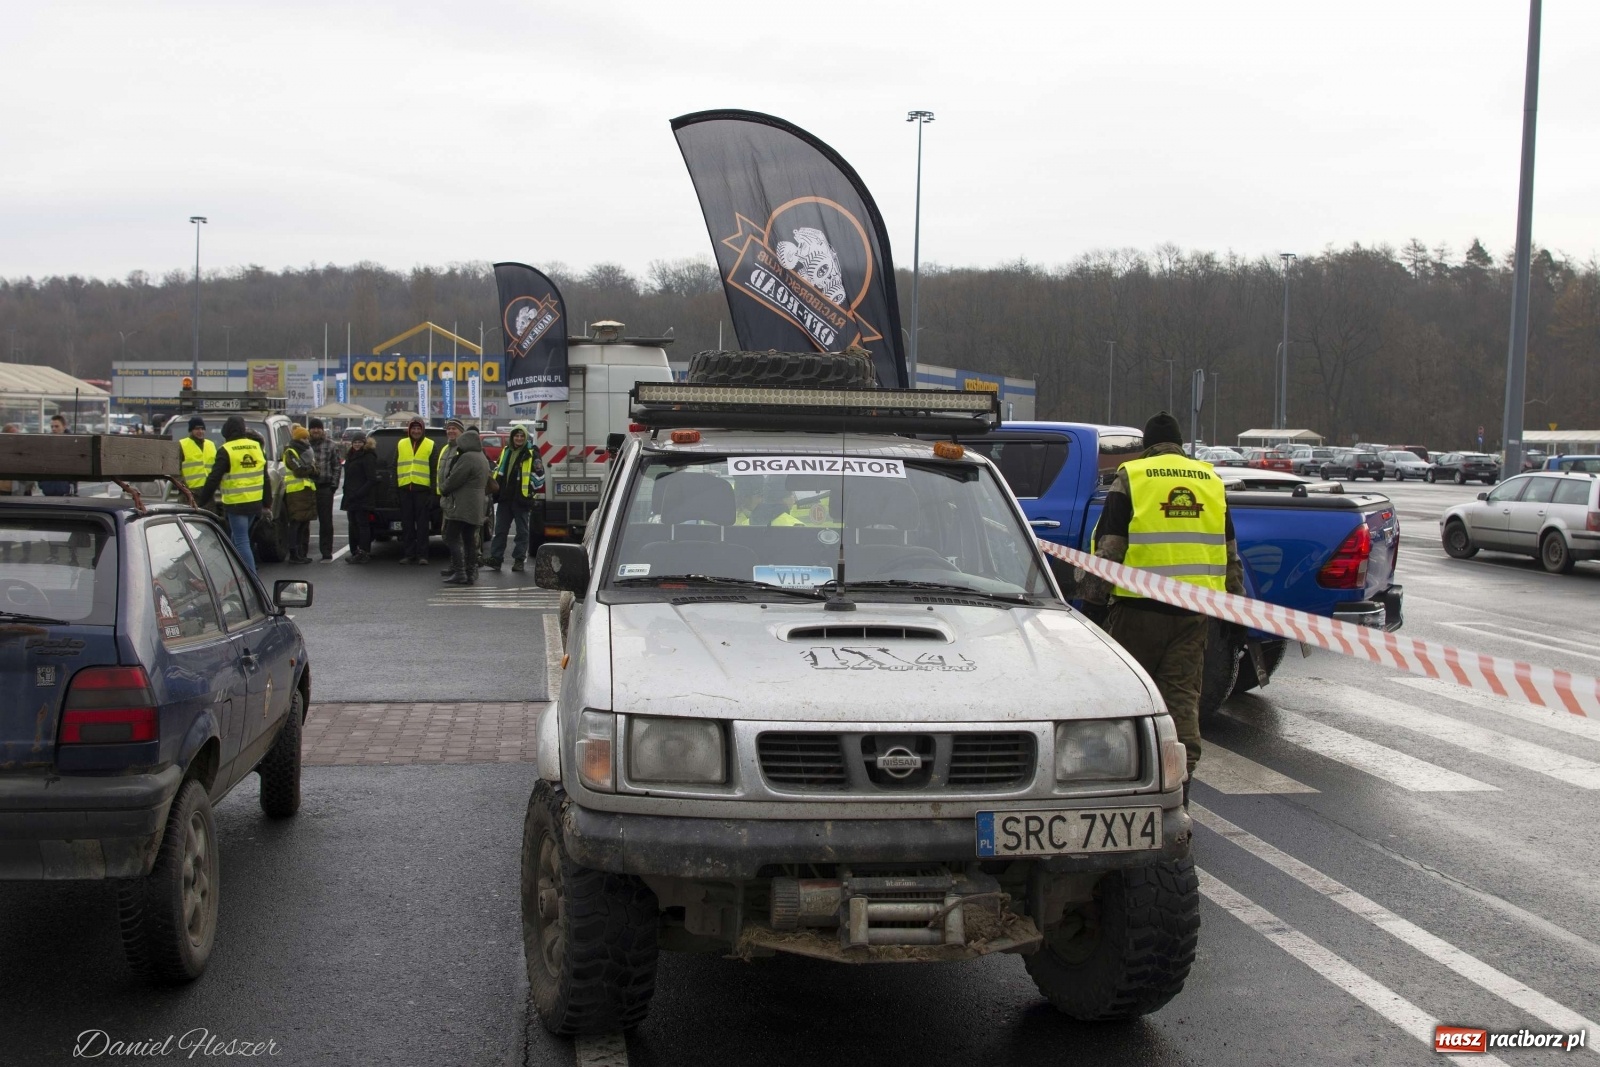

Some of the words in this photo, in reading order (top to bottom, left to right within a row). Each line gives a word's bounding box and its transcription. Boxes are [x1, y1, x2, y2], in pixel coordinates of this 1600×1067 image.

[522, 313, 553, 349] OFF-ROAD
[352, 357, 500, 382] castorama
[733, 459, 900, 475] ORGANIZATOR
[980, 839, 993, 849] PL
[1002, 814, 1068, 850] SRC
[1080, 811, 1156, 849] 7XY4
